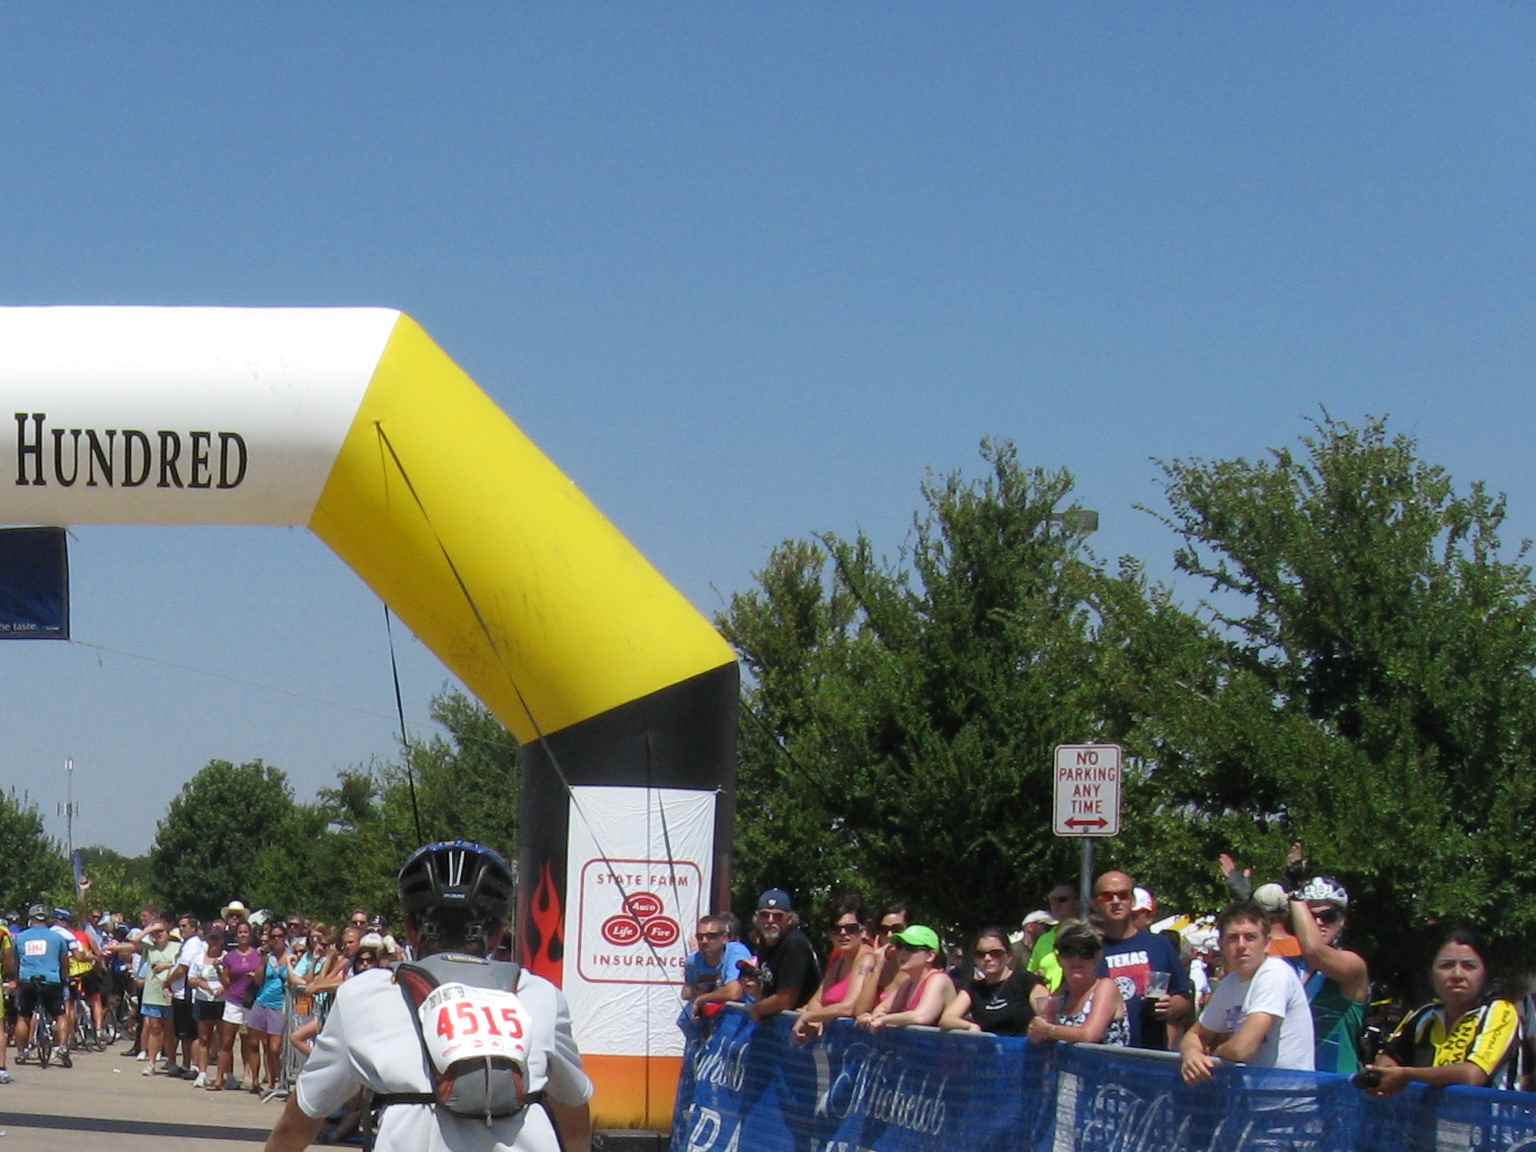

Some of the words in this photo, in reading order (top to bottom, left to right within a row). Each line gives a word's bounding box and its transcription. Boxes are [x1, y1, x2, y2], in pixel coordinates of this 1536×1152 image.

[14, 413, 247, 489] HUNDRED
[1077, 751, 1098, 765] NO
[1059, 767, 1116, 781] PARKING
[1073, 784, 1101, 797] ANY
[1071, 800, 1104, 813] TIME
[597, 873, 642, 886] STATE
[612, 925, 633, 938] Life
[651, 926, 671, 937] Fire
[592, 954, 685, 968] INSURANCE
[1105, 951, 1149, 969] TEXAS
[437, 1002, 524, 1041] 4515
[829, 1043, 949, 1136] Michelob
